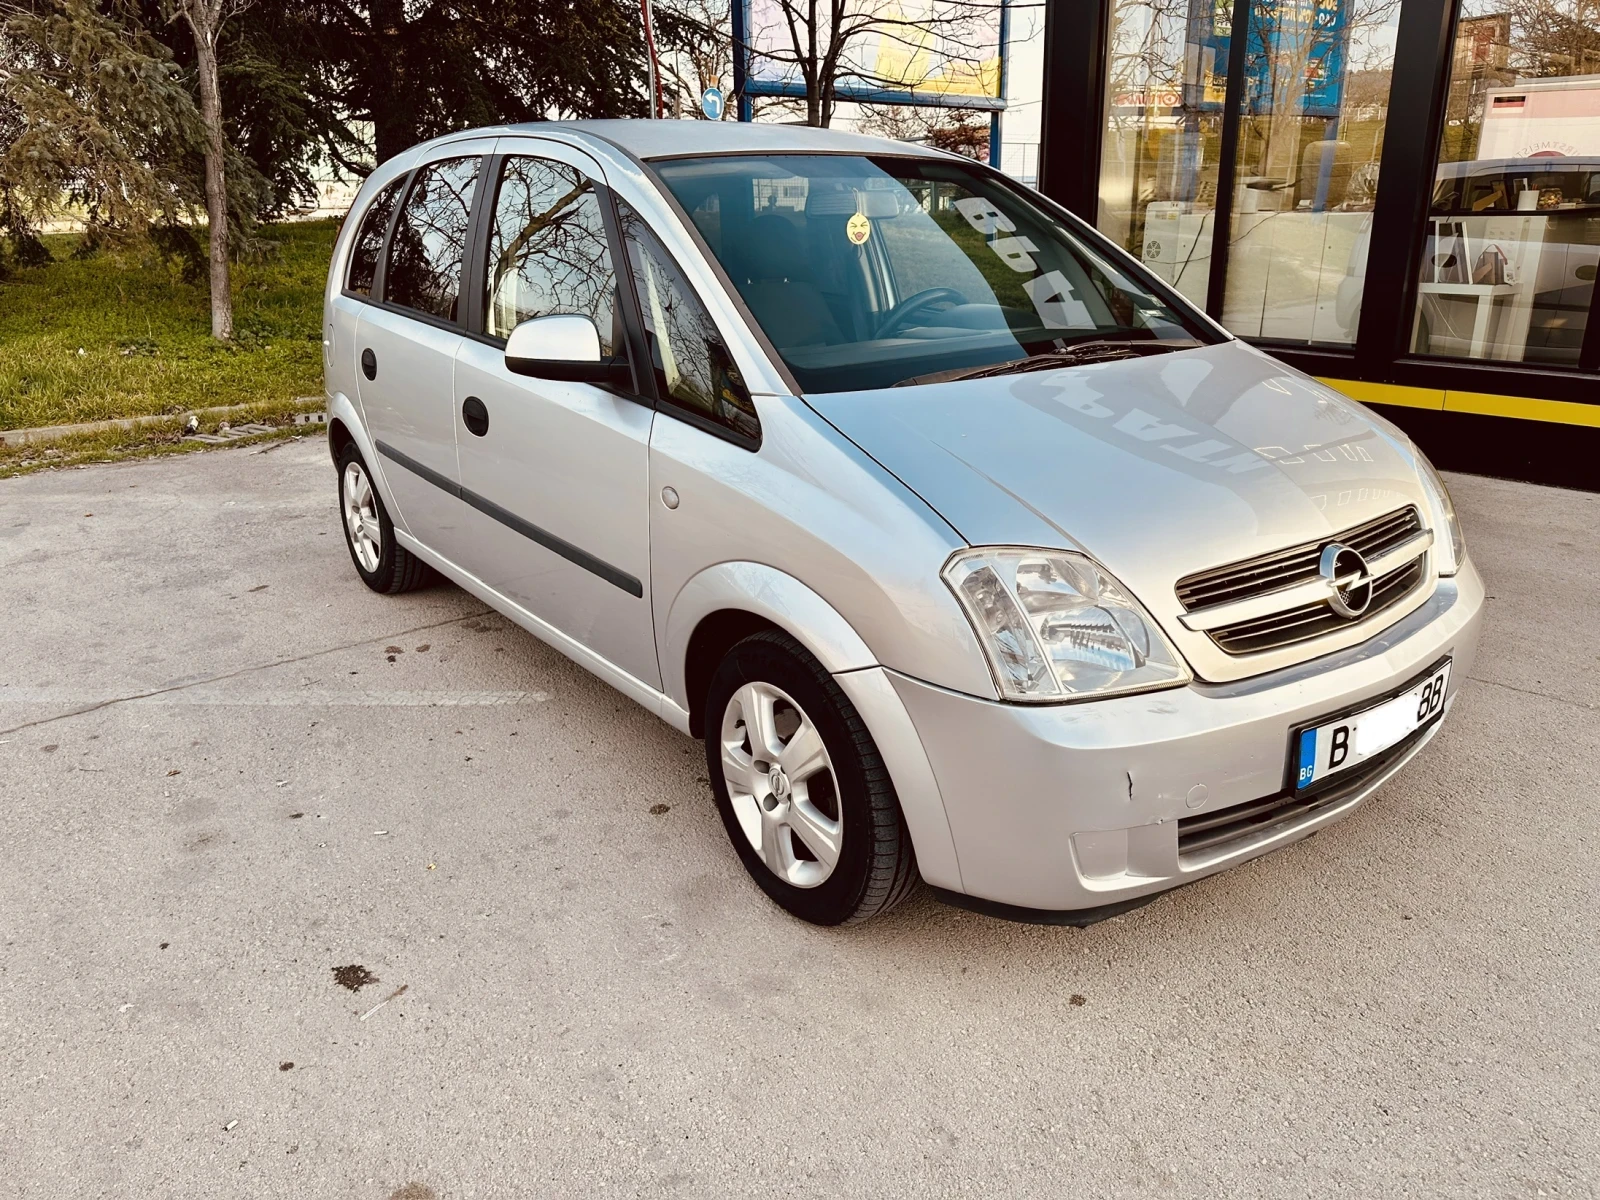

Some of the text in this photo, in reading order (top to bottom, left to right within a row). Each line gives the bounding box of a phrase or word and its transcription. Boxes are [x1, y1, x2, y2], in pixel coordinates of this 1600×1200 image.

[1328, 674, 1444, 770] B BB
[1299, 765, 1313, 780] BG
